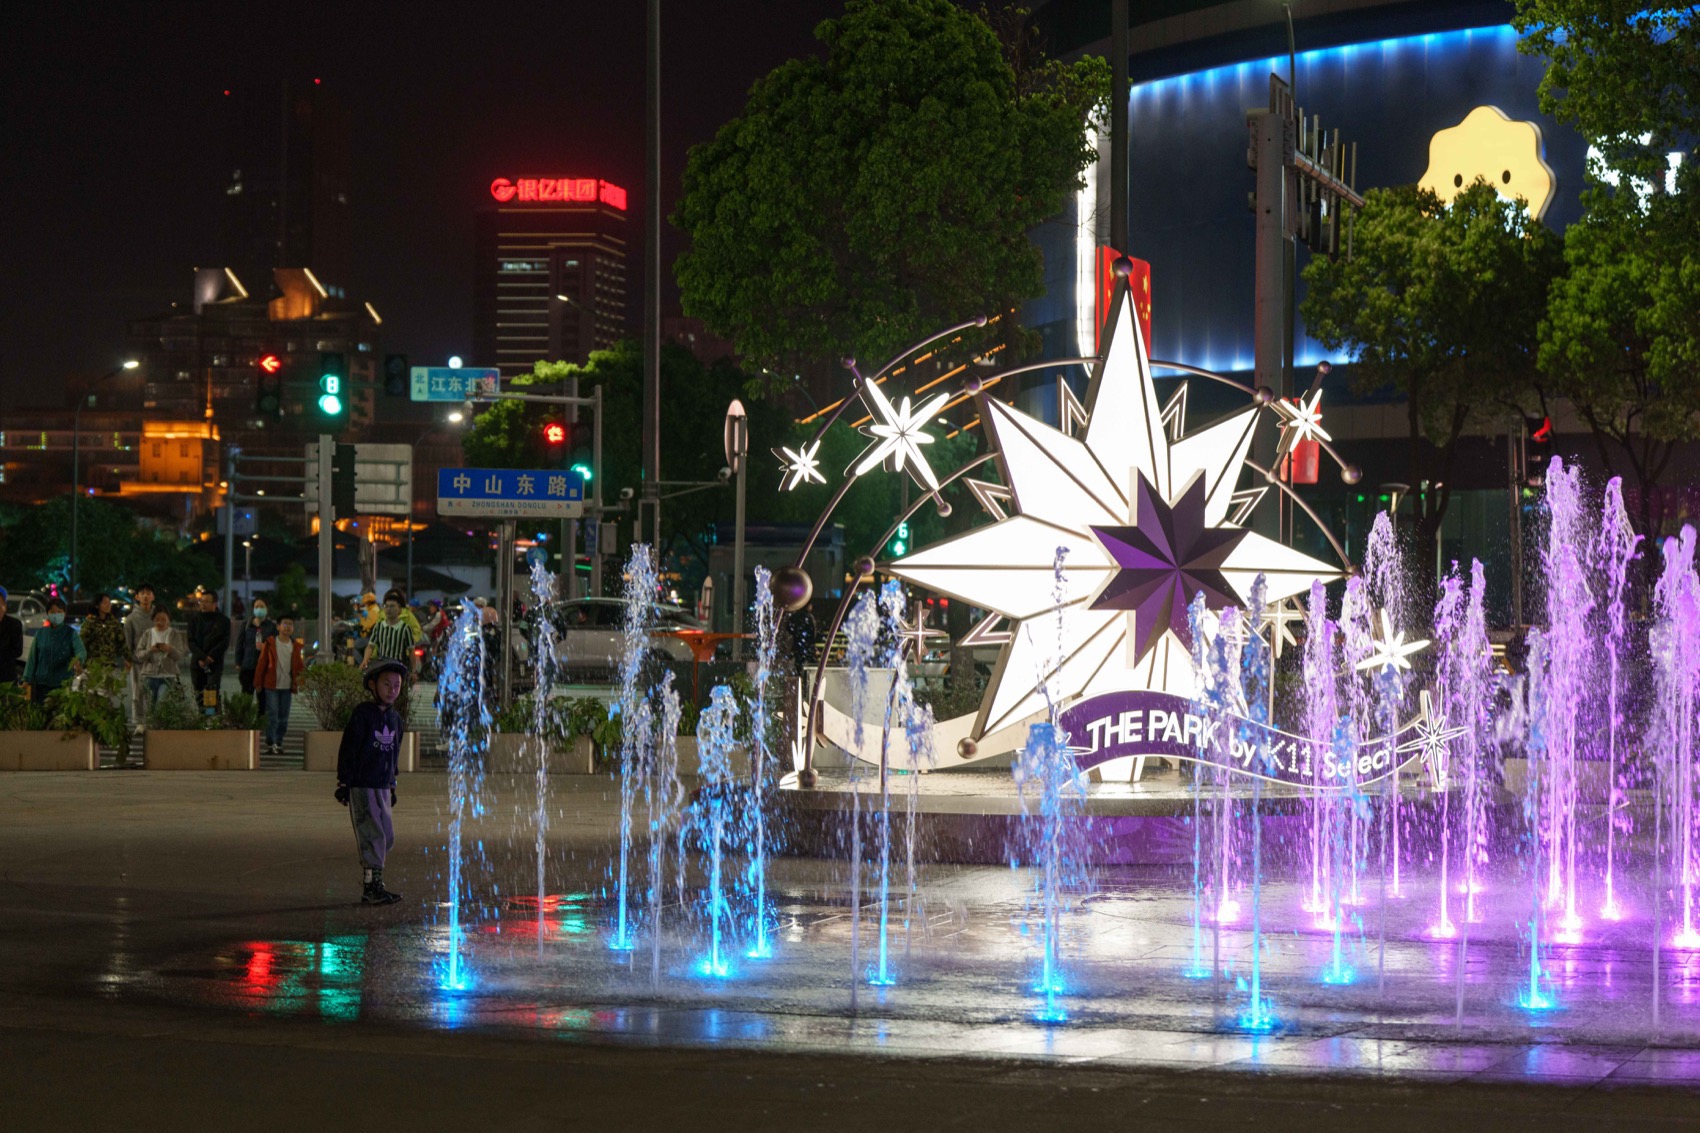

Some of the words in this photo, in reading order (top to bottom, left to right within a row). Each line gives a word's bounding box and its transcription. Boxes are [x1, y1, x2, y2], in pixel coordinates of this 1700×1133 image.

[517, 178, 597, 201] 银亿集团
[326, 376, 339, 394] 8
[453, 473, 567, 496] 中山东路
[898, 523, 908, 538] 6
[1086, 710, 1143, 752] THE
[1148, 710, 1222, 752] PARK
[1229, 727, 1257, 767] by
[1267, 736, 1313, 777] K11
[1323, 742, 1393, 778] Select
